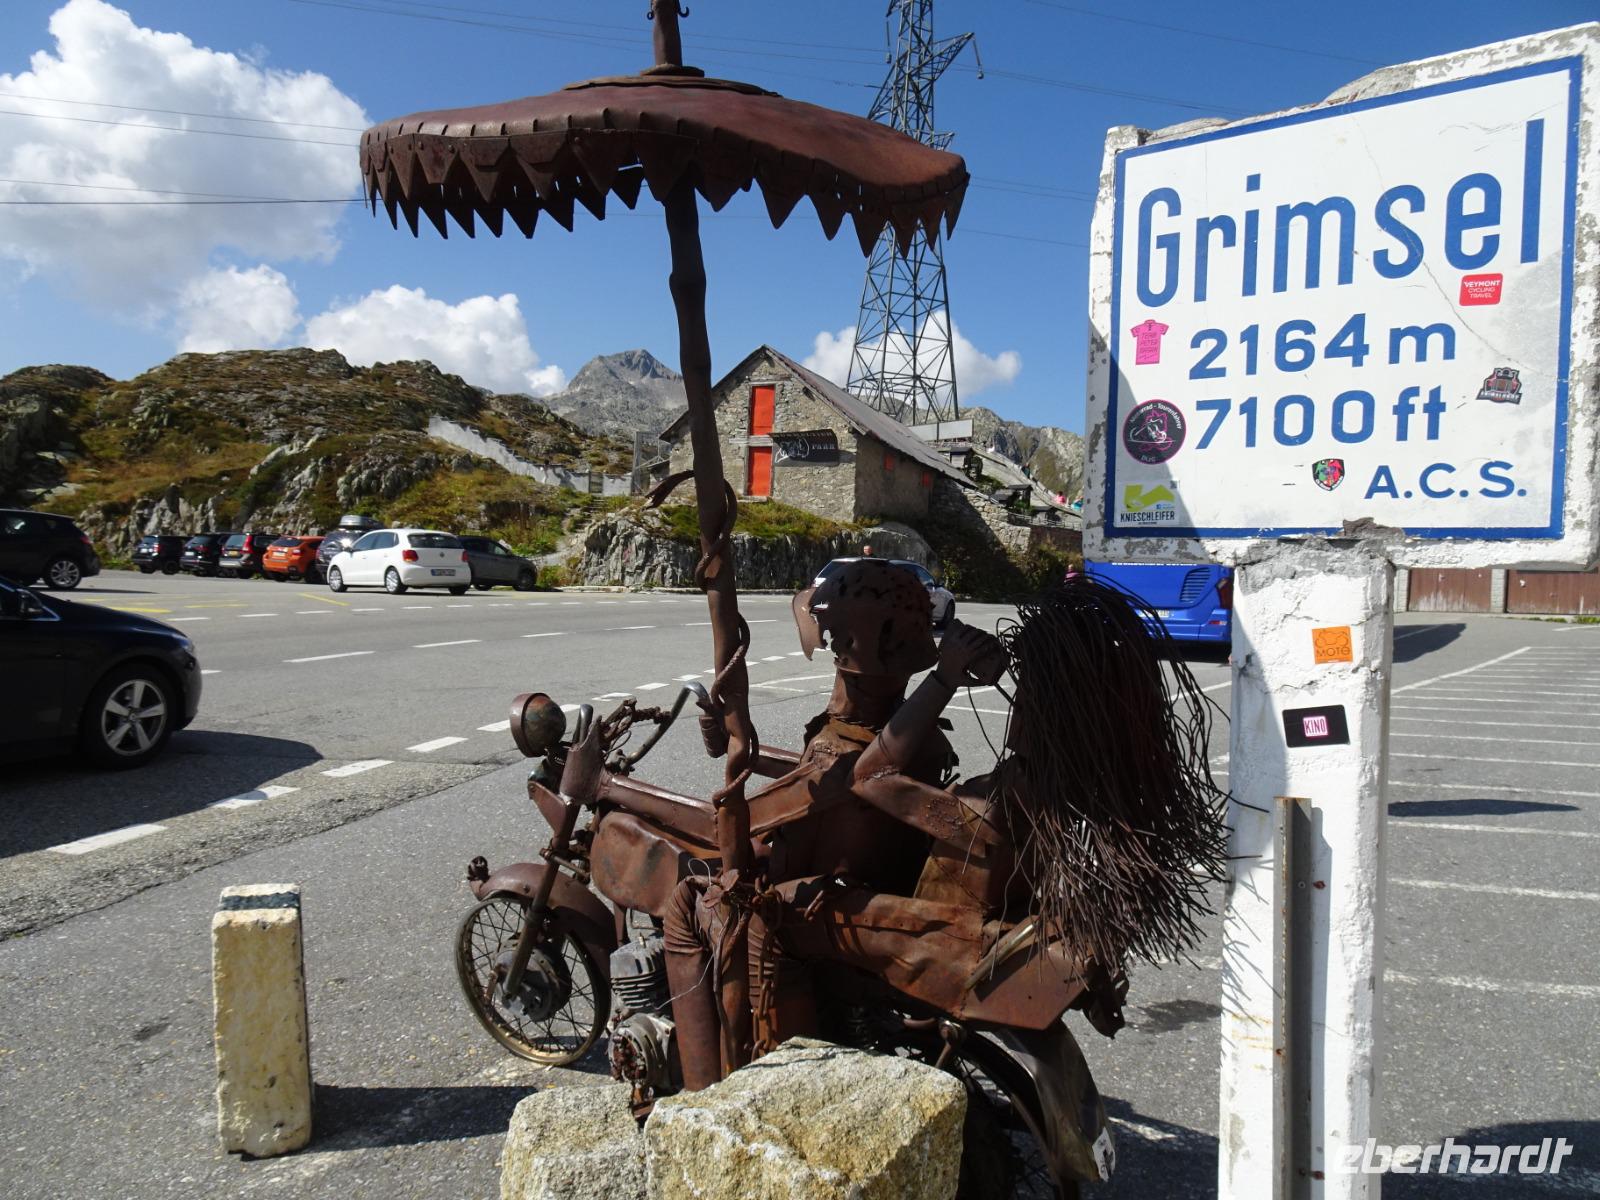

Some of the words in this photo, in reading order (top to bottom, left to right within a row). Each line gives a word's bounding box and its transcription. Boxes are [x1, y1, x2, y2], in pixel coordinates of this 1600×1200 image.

[1136, 119, 1545, 308] Grimsel
[1464, 280, 1501, 288] VEYMONT
[1189, 313, 1370, 380] 2164
[1388, 323, 1456, 364] m
[1195, 390, 1375, 449] 7100
[1392, 384, 1447, 442] ft
[1364, 460, 1528, 499] A.C.S.
[1120, 511, 1175, 522] KNIESCHLEIFER
[1316, 646, 1351, 657] MOTO
[1304, 717, 1327, 734] KINO
